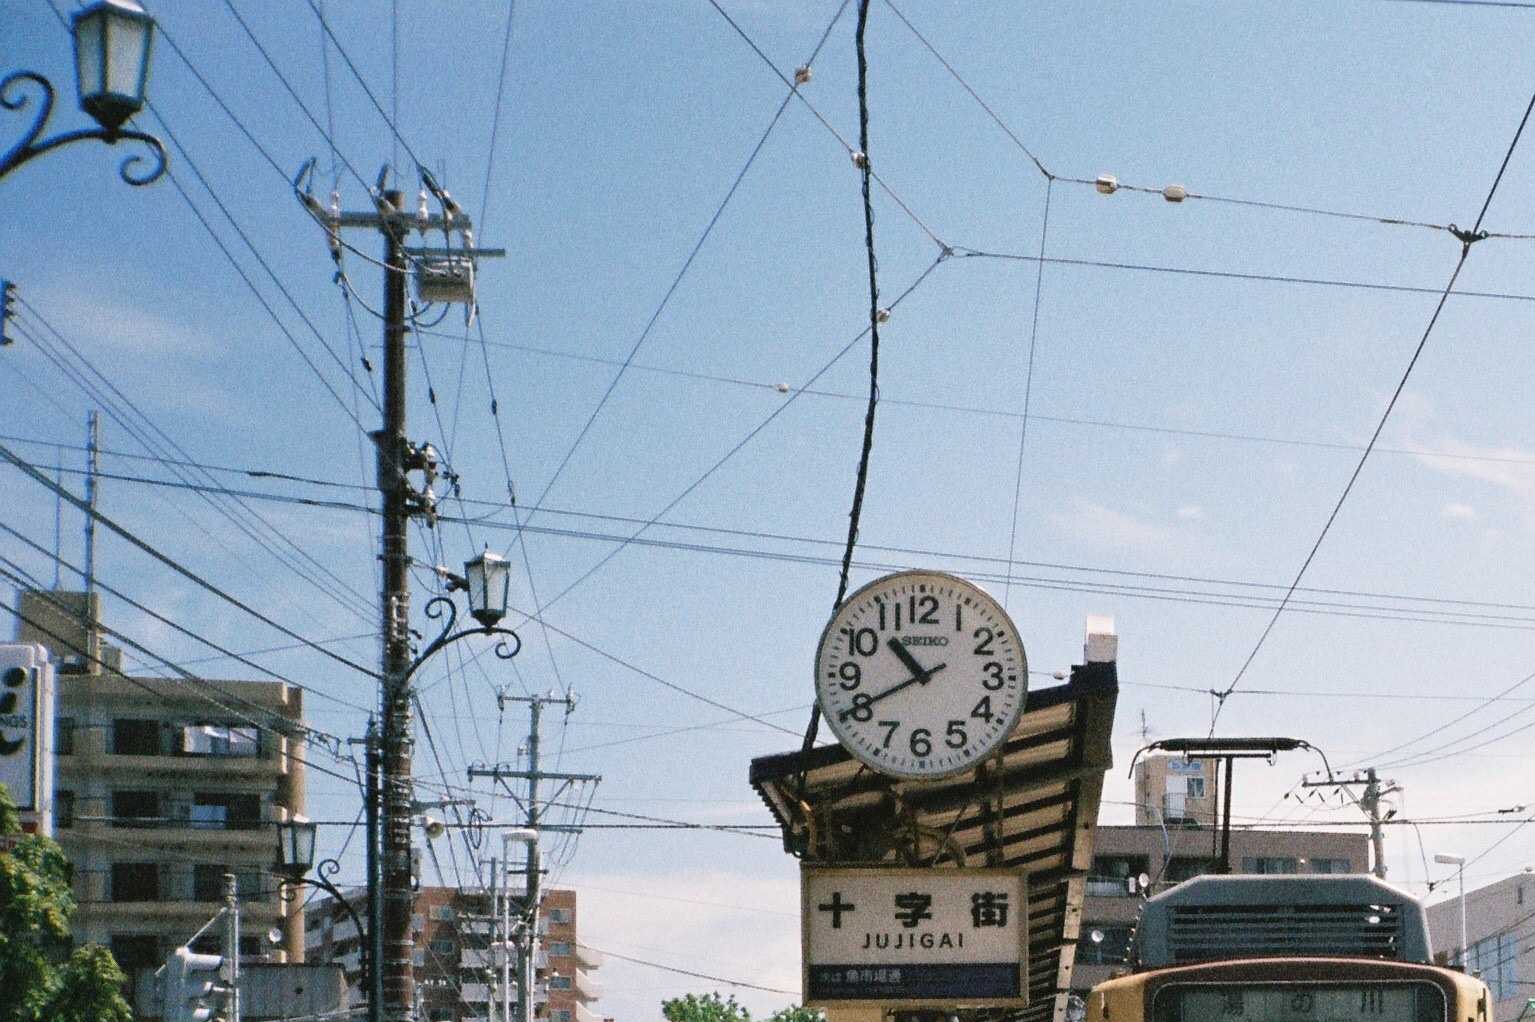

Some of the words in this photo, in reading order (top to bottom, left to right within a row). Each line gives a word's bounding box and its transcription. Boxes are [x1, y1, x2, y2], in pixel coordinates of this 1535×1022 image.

[880, 603, 900, 631] 11
[910, 595, 939, 624] 12
[956, 604, 962, 631] 1
[850, 627, 878, 657] 10
[902, 636, 949, 647] SEIKO
[973, 627, 994, 655] 2
[839, 661, 861, 691] 9
[982, 661, 1004, 691] 3
[852, 693, 873, 722] 8
[971, 695, 994, 723] 4
[879, 721, 900, 748] 7
[910, 728, 932, 757] 6
[945, 720, 968, 749] 5
[818, 892, 1009, 929] 十字街
[862, 933, 963, 949] JUJIGAI
